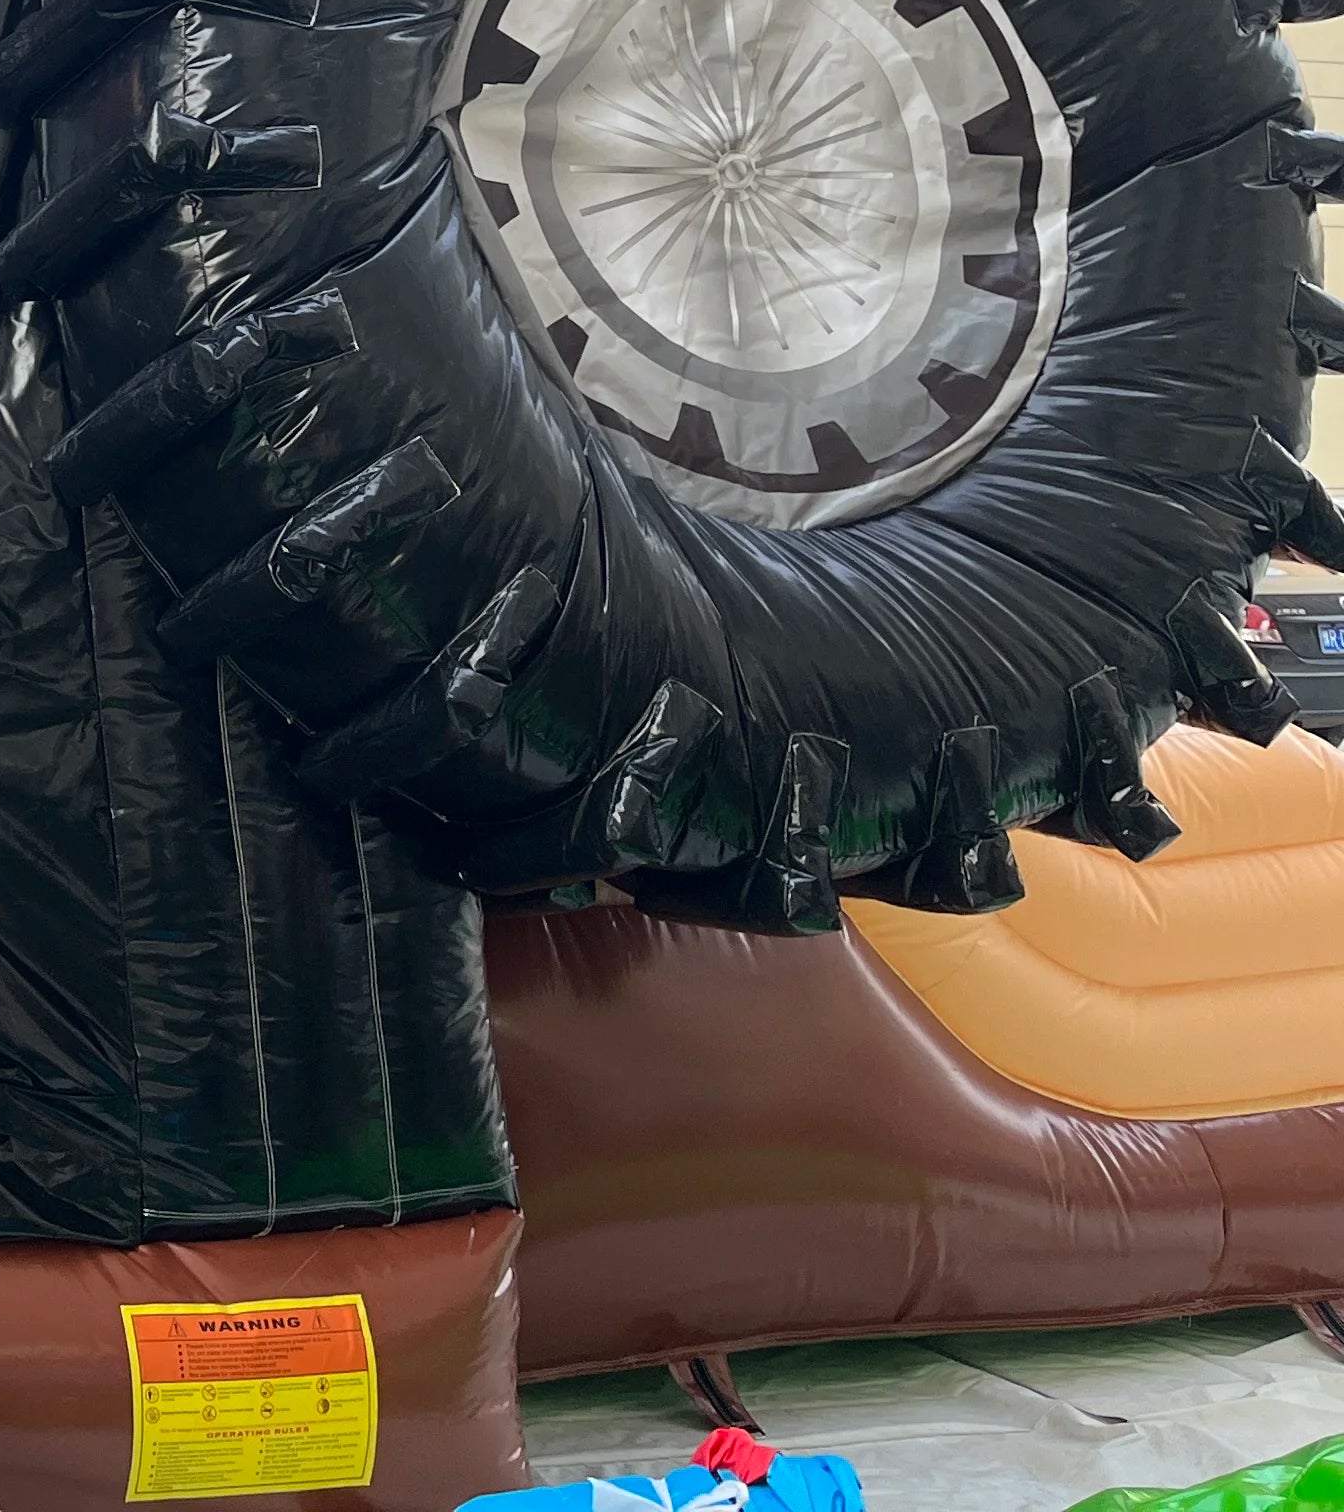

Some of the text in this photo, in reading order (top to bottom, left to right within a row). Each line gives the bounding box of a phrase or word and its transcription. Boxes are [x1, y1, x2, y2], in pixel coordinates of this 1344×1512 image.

[198, 1316, 301, 1332] WARNING
[206, 1425, 310, 1439] OPERATING RULES
